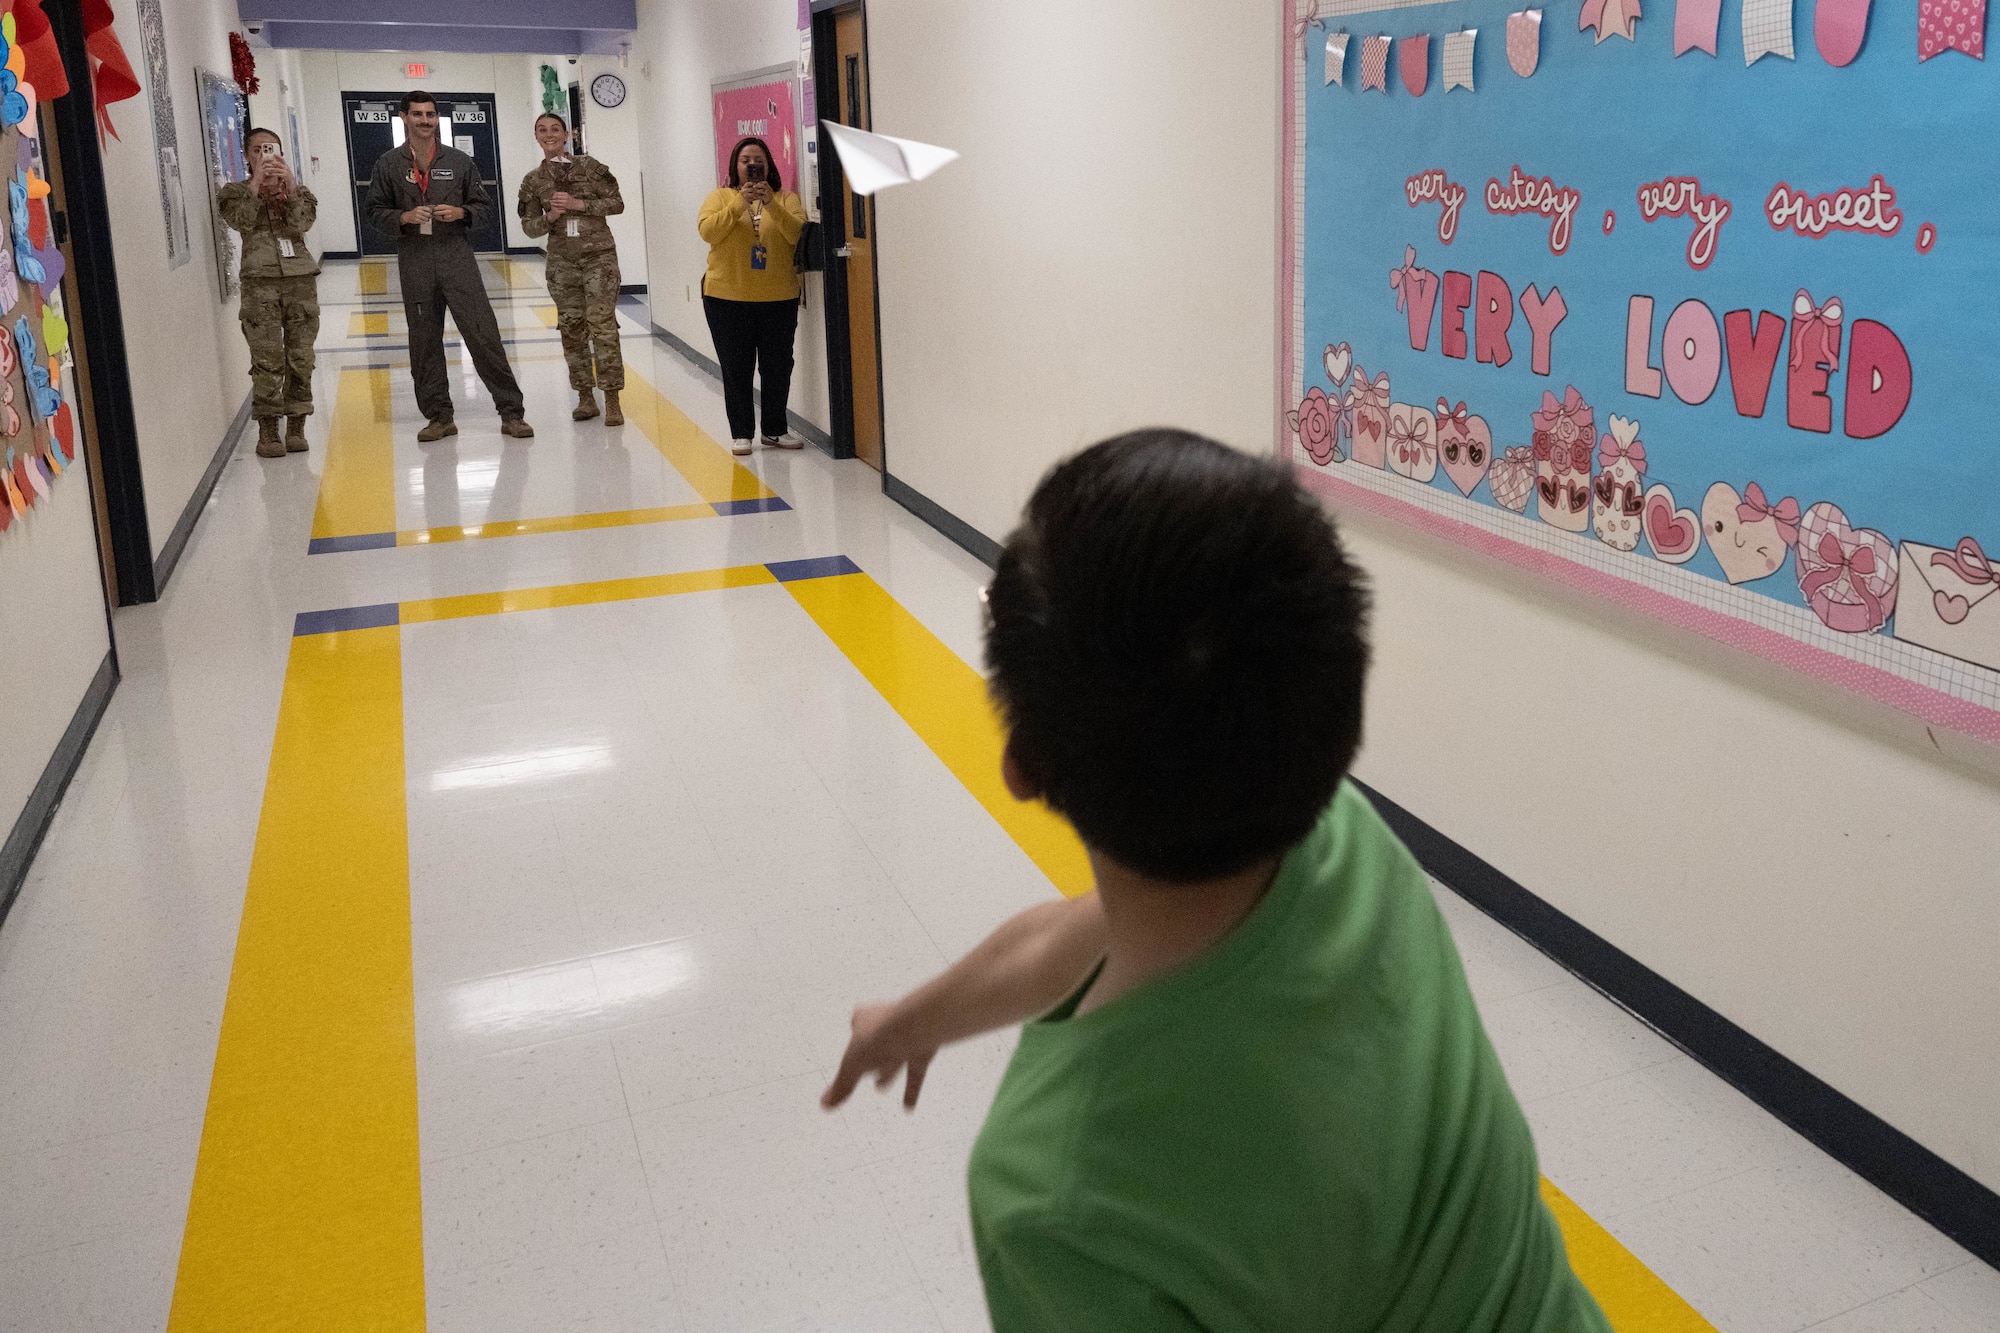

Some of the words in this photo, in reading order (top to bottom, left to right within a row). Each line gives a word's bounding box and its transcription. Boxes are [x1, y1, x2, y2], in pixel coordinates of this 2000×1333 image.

[408, 64, 426, 77] EXIT
[358, 112, 369, 121] W
[373, 113, 387, 121] 35
[470, 113, 484, 122] 36
[1405, 169, 1466, 244] very
[1485, 166, 1580, 255] cutesy
[1638, 176, 1731, 271] very
[1766, 174, 1903, 239] sweet
[1404, 270, 1568, 376] VERY
[1625, 294, 1913, 439] LOVED
